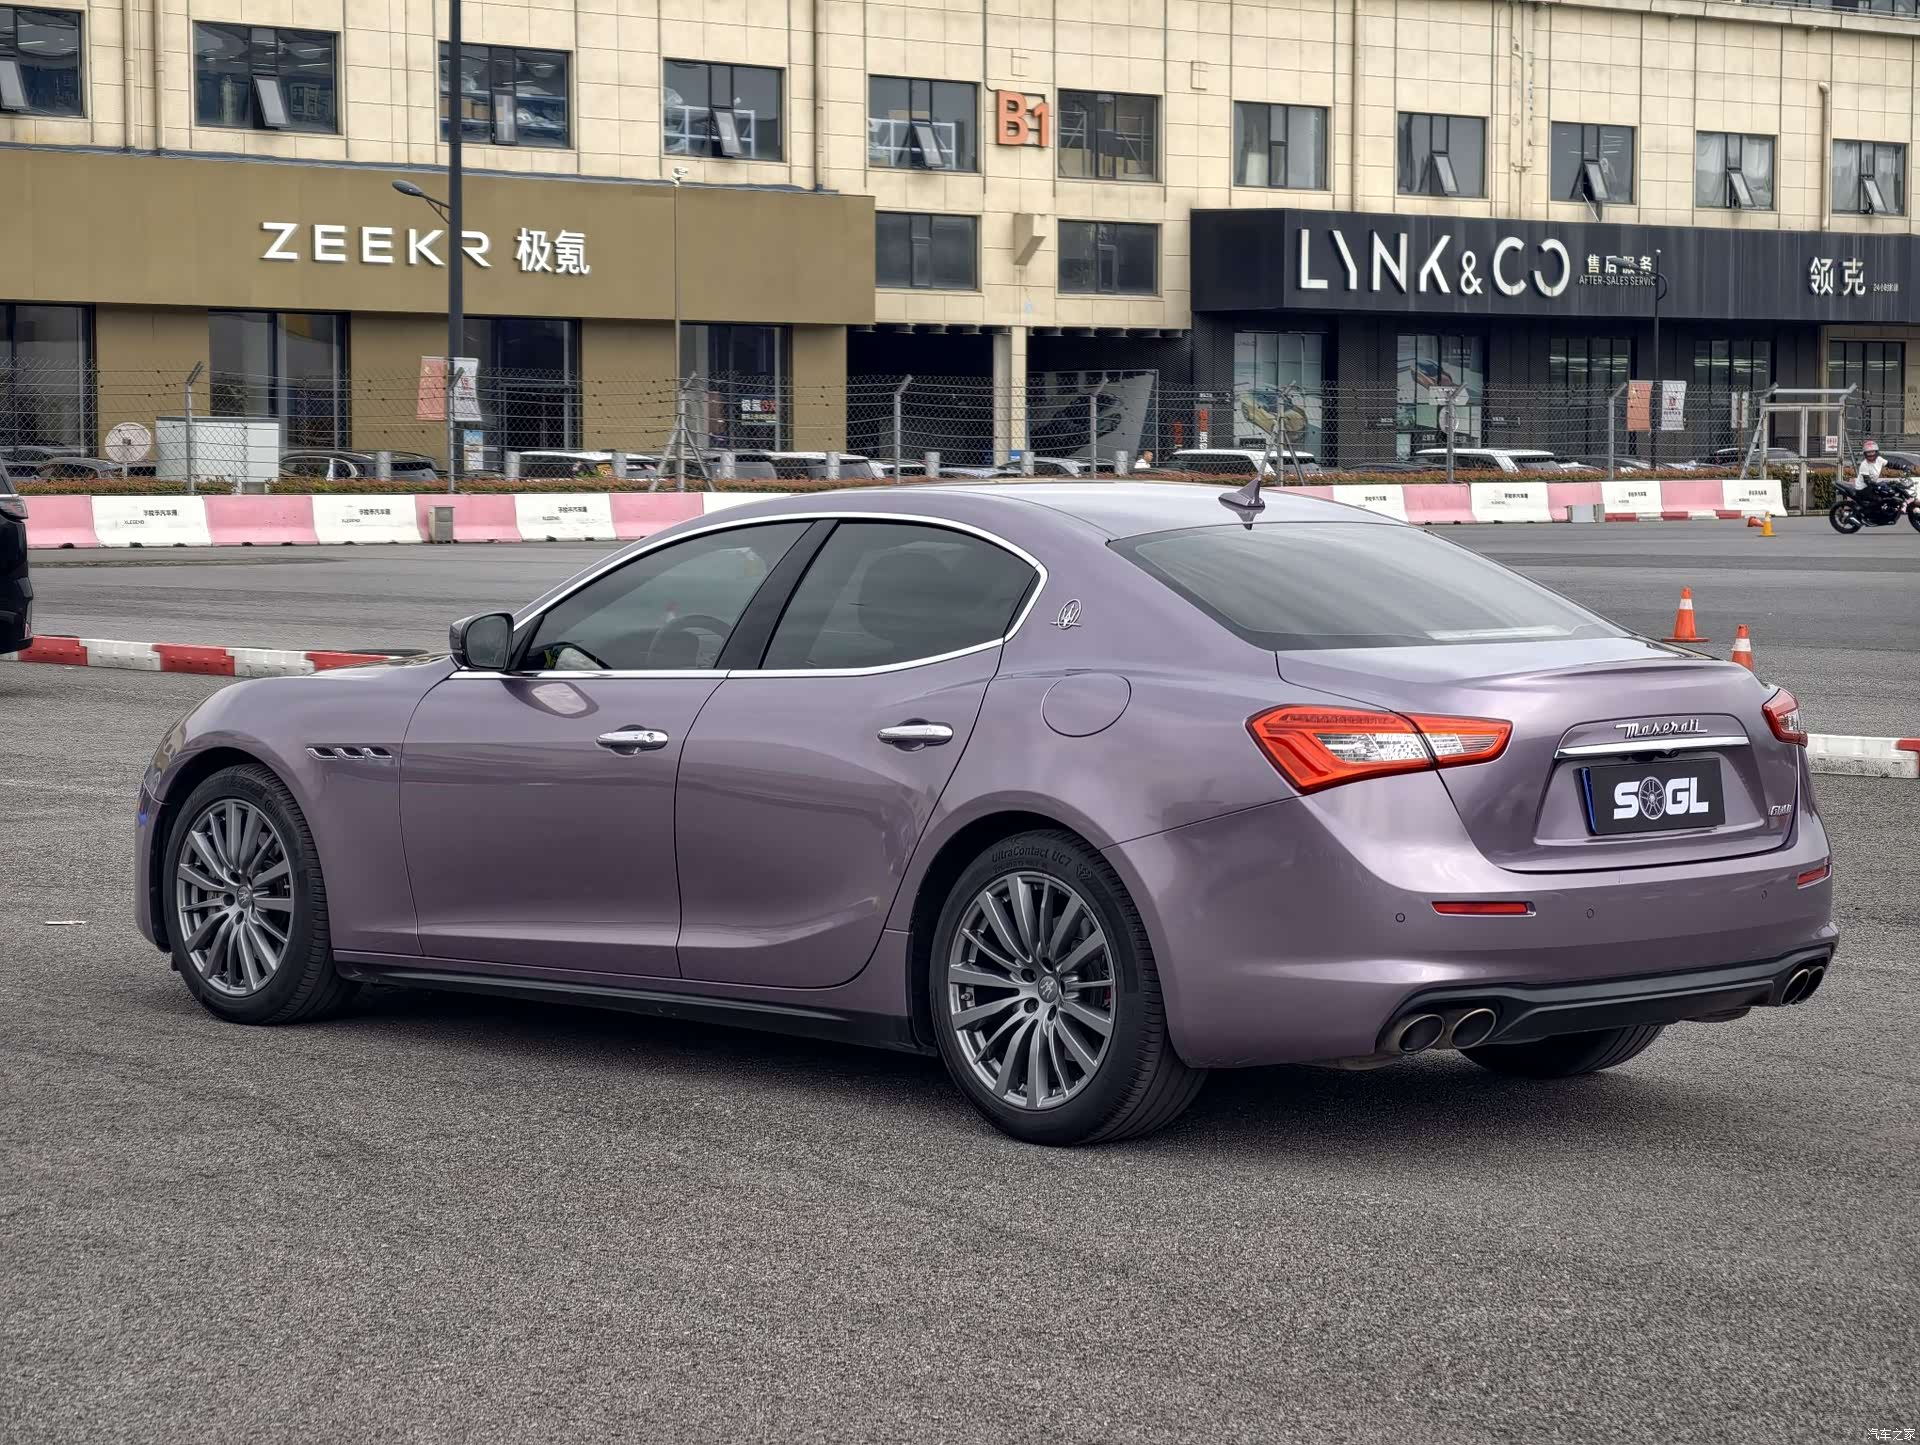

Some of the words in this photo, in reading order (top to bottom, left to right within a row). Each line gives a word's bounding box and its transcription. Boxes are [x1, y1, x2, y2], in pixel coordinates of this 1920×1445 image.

[996, 89, 1049, 147] B1
[260, 221, 493, 268] ZEEKR
[516, 227, 592, 275] 极氪
[1579, 274, 1629, 286] AFTER-SALES
[1629, 276, 1657, 286] SERVIC
[1809, 256, 1867, 296] 领克
[1615, 718, 1708, 739] Maserati
[990, 845, 1050, 863] UltraContact
[1051, 849, 1073, 867] UC7
